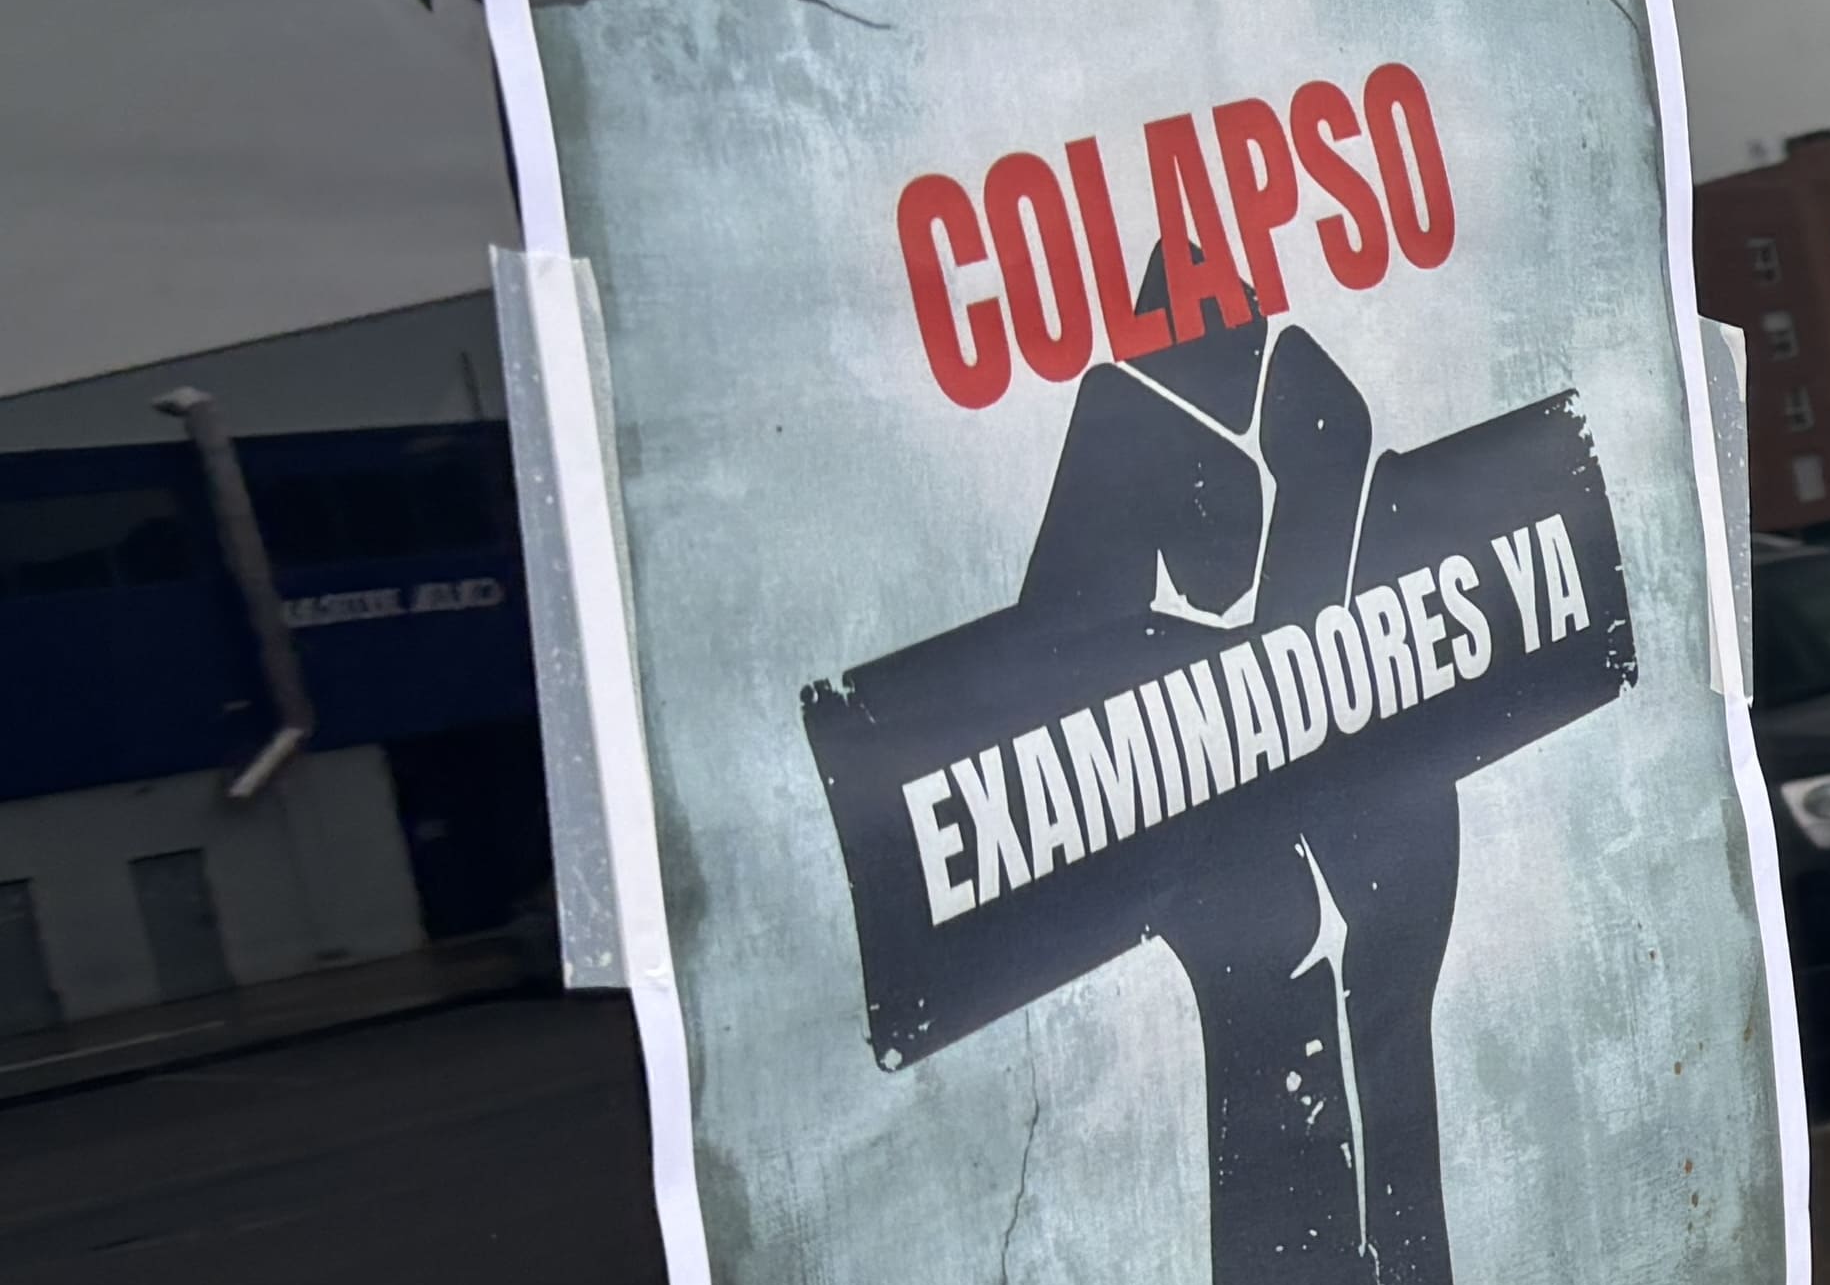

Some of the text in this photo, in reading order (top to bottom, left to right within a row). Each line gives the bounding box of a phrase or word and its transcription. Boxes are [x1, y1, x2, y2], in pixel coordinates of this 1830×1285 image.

[896, 62, 1456, 410] COLAPSO
[902, 513, 1590, 926] EXAMINADORES YA
